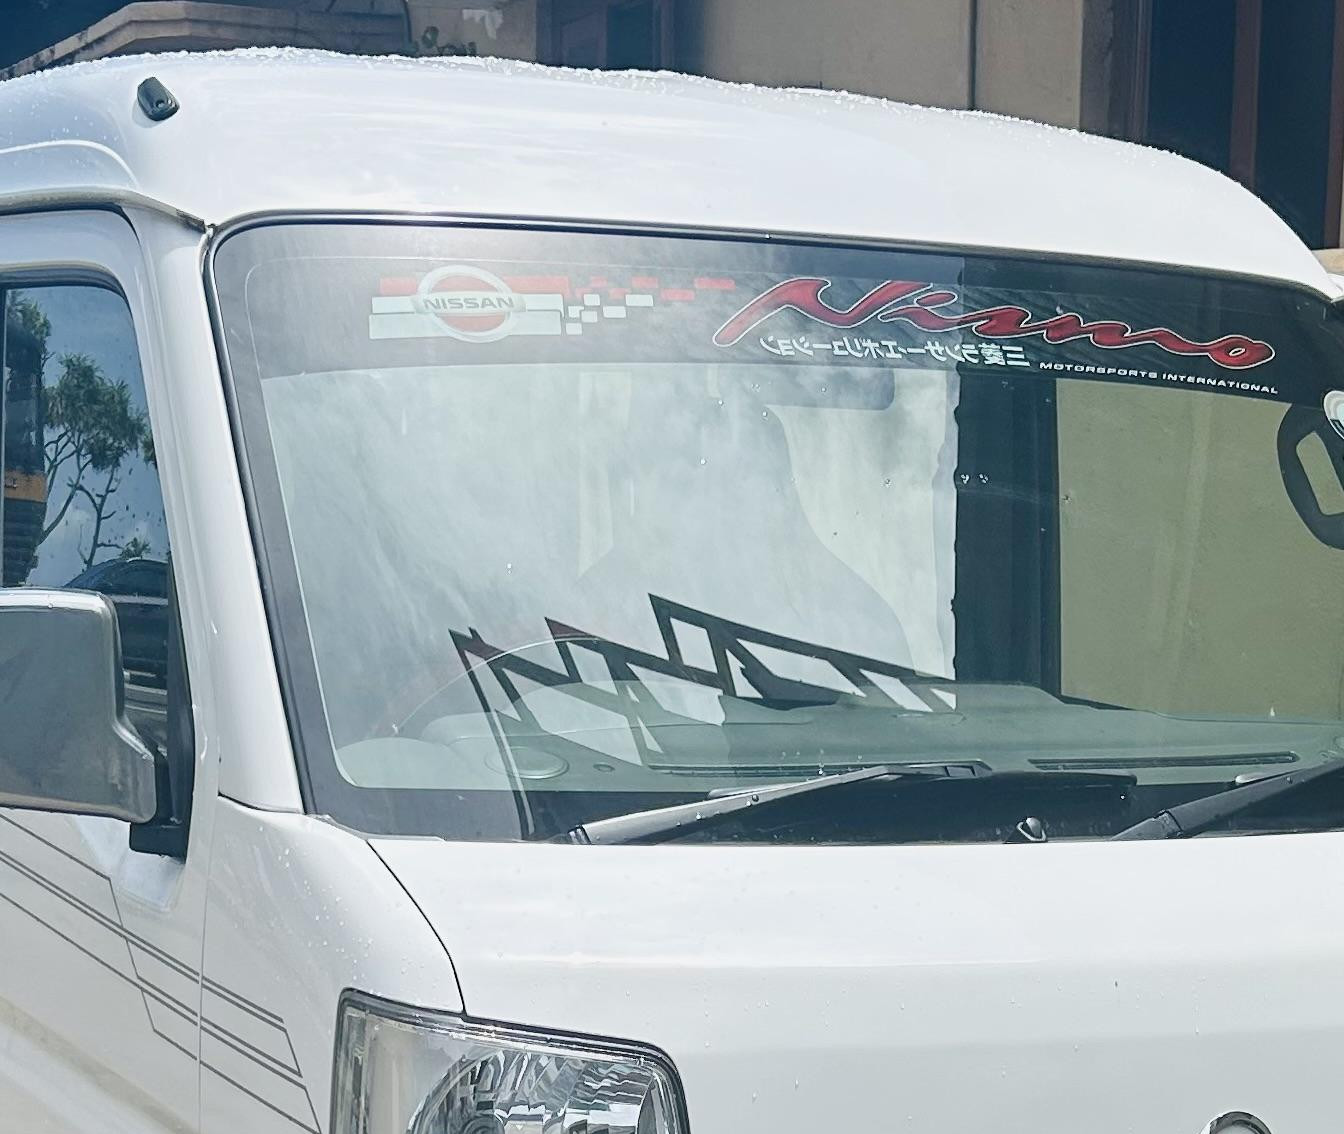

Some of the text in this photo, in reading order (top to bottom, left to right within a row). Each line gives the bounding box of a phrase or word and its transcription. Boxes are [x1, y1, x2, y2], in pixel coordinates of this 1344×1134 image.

[422, 295, 514, 311] NISSAN
[1039, 361, 1279, 395] MOTORSPORTS INTERNATIONAL
